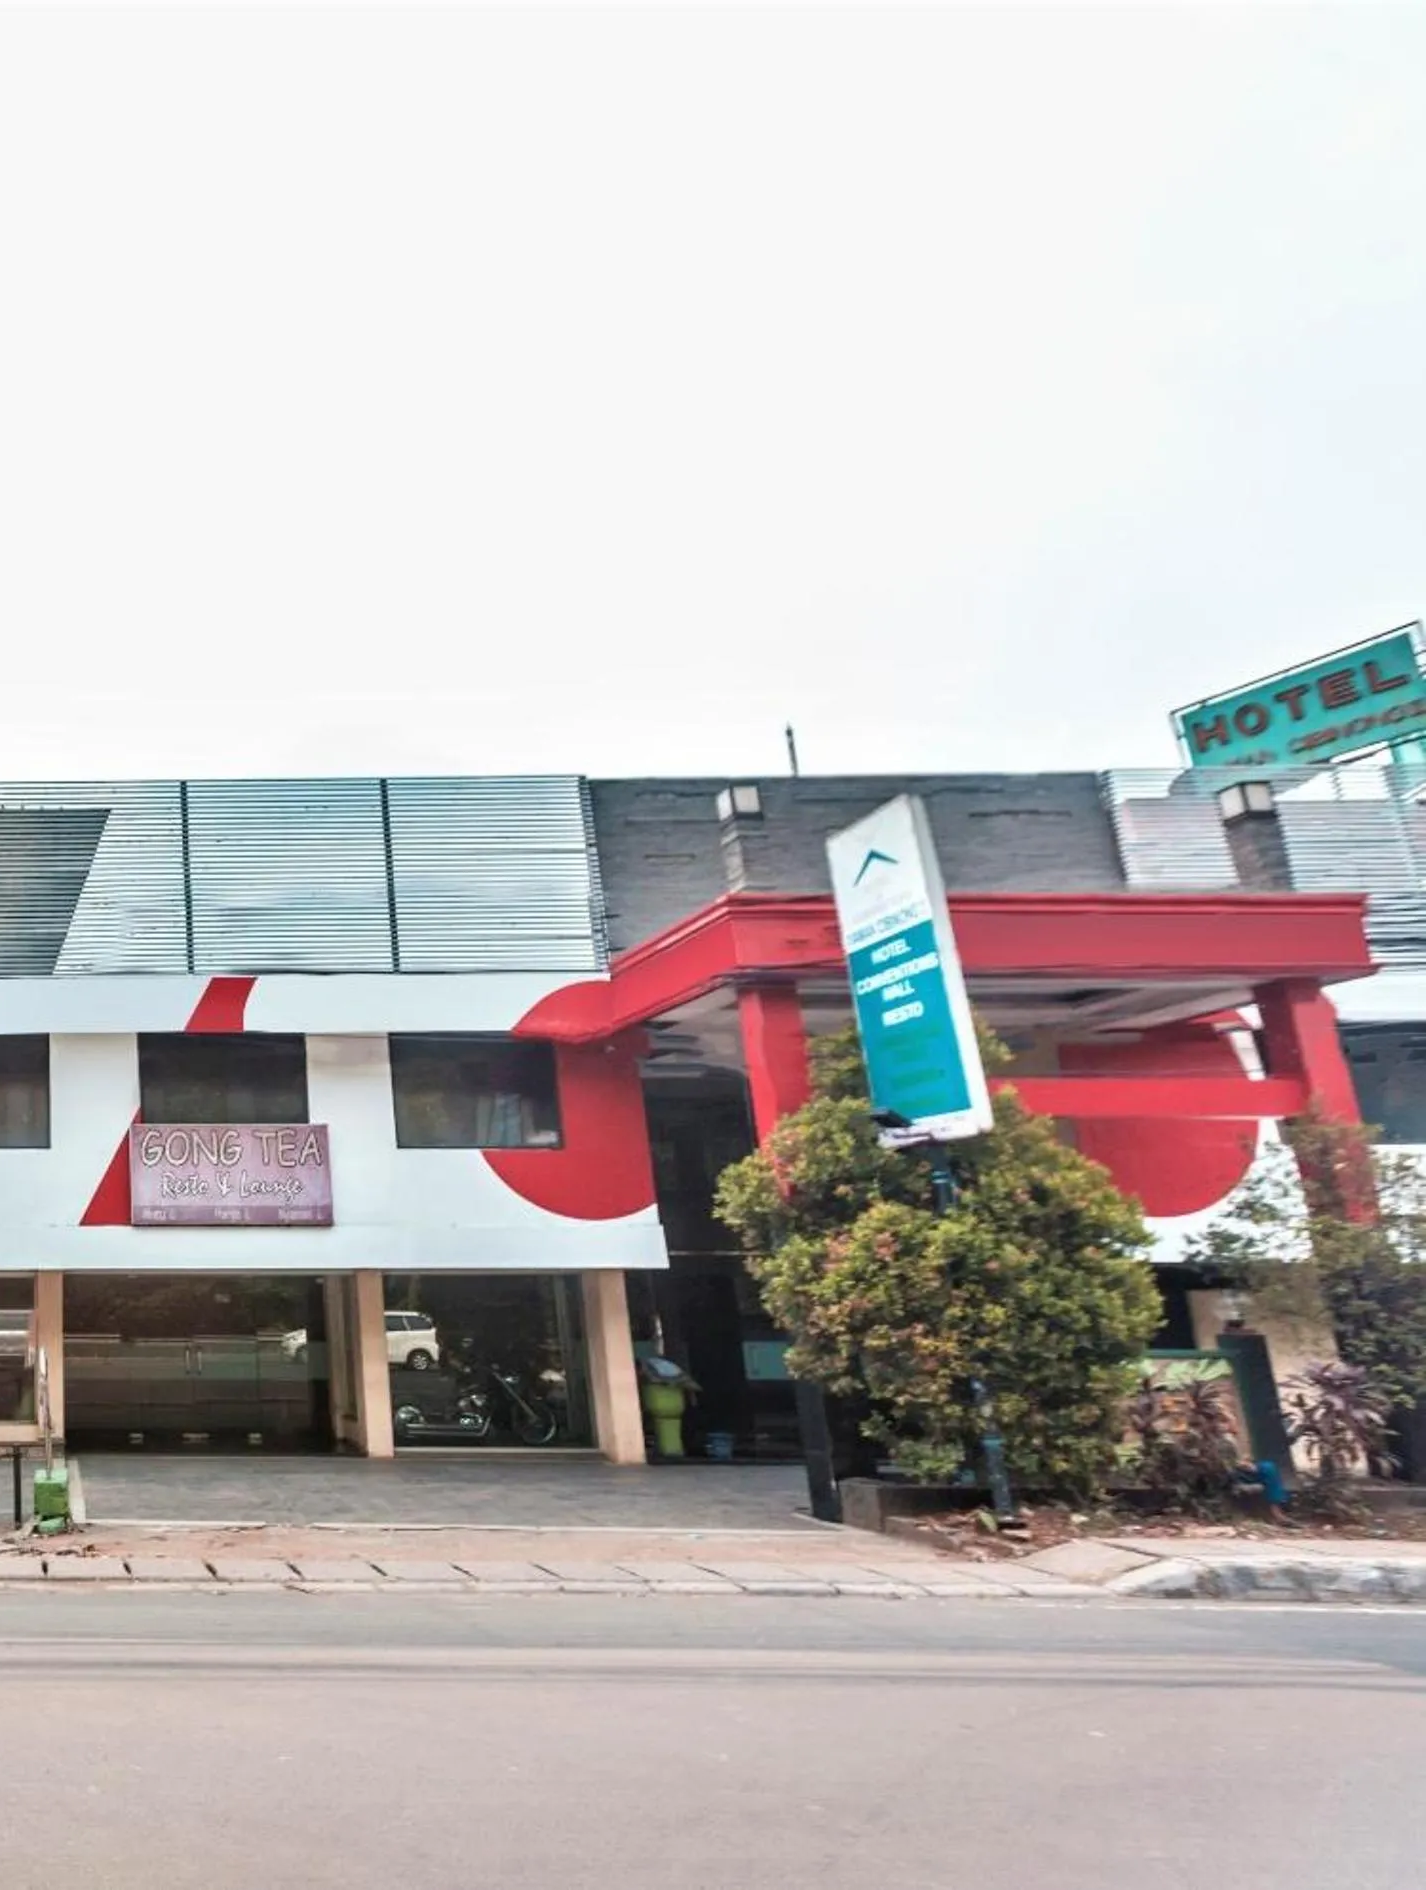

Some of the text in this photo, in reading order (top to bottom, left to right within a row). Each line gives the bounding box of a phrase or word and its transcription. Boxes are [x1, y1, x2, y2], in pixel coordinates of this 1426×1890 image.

[1191, 661, 1412, 753] HOTEL
[871, 938, 912, 965] HOTEL
[882, 979, 915, 1002] HALL
[881, 1000, 924, 1027] RESTO
[140, 1128, 323, 1168] GONG TEA
[160, 1172, 210, 1199] Resto
[239, 1171, 305, 1202] Lounge
